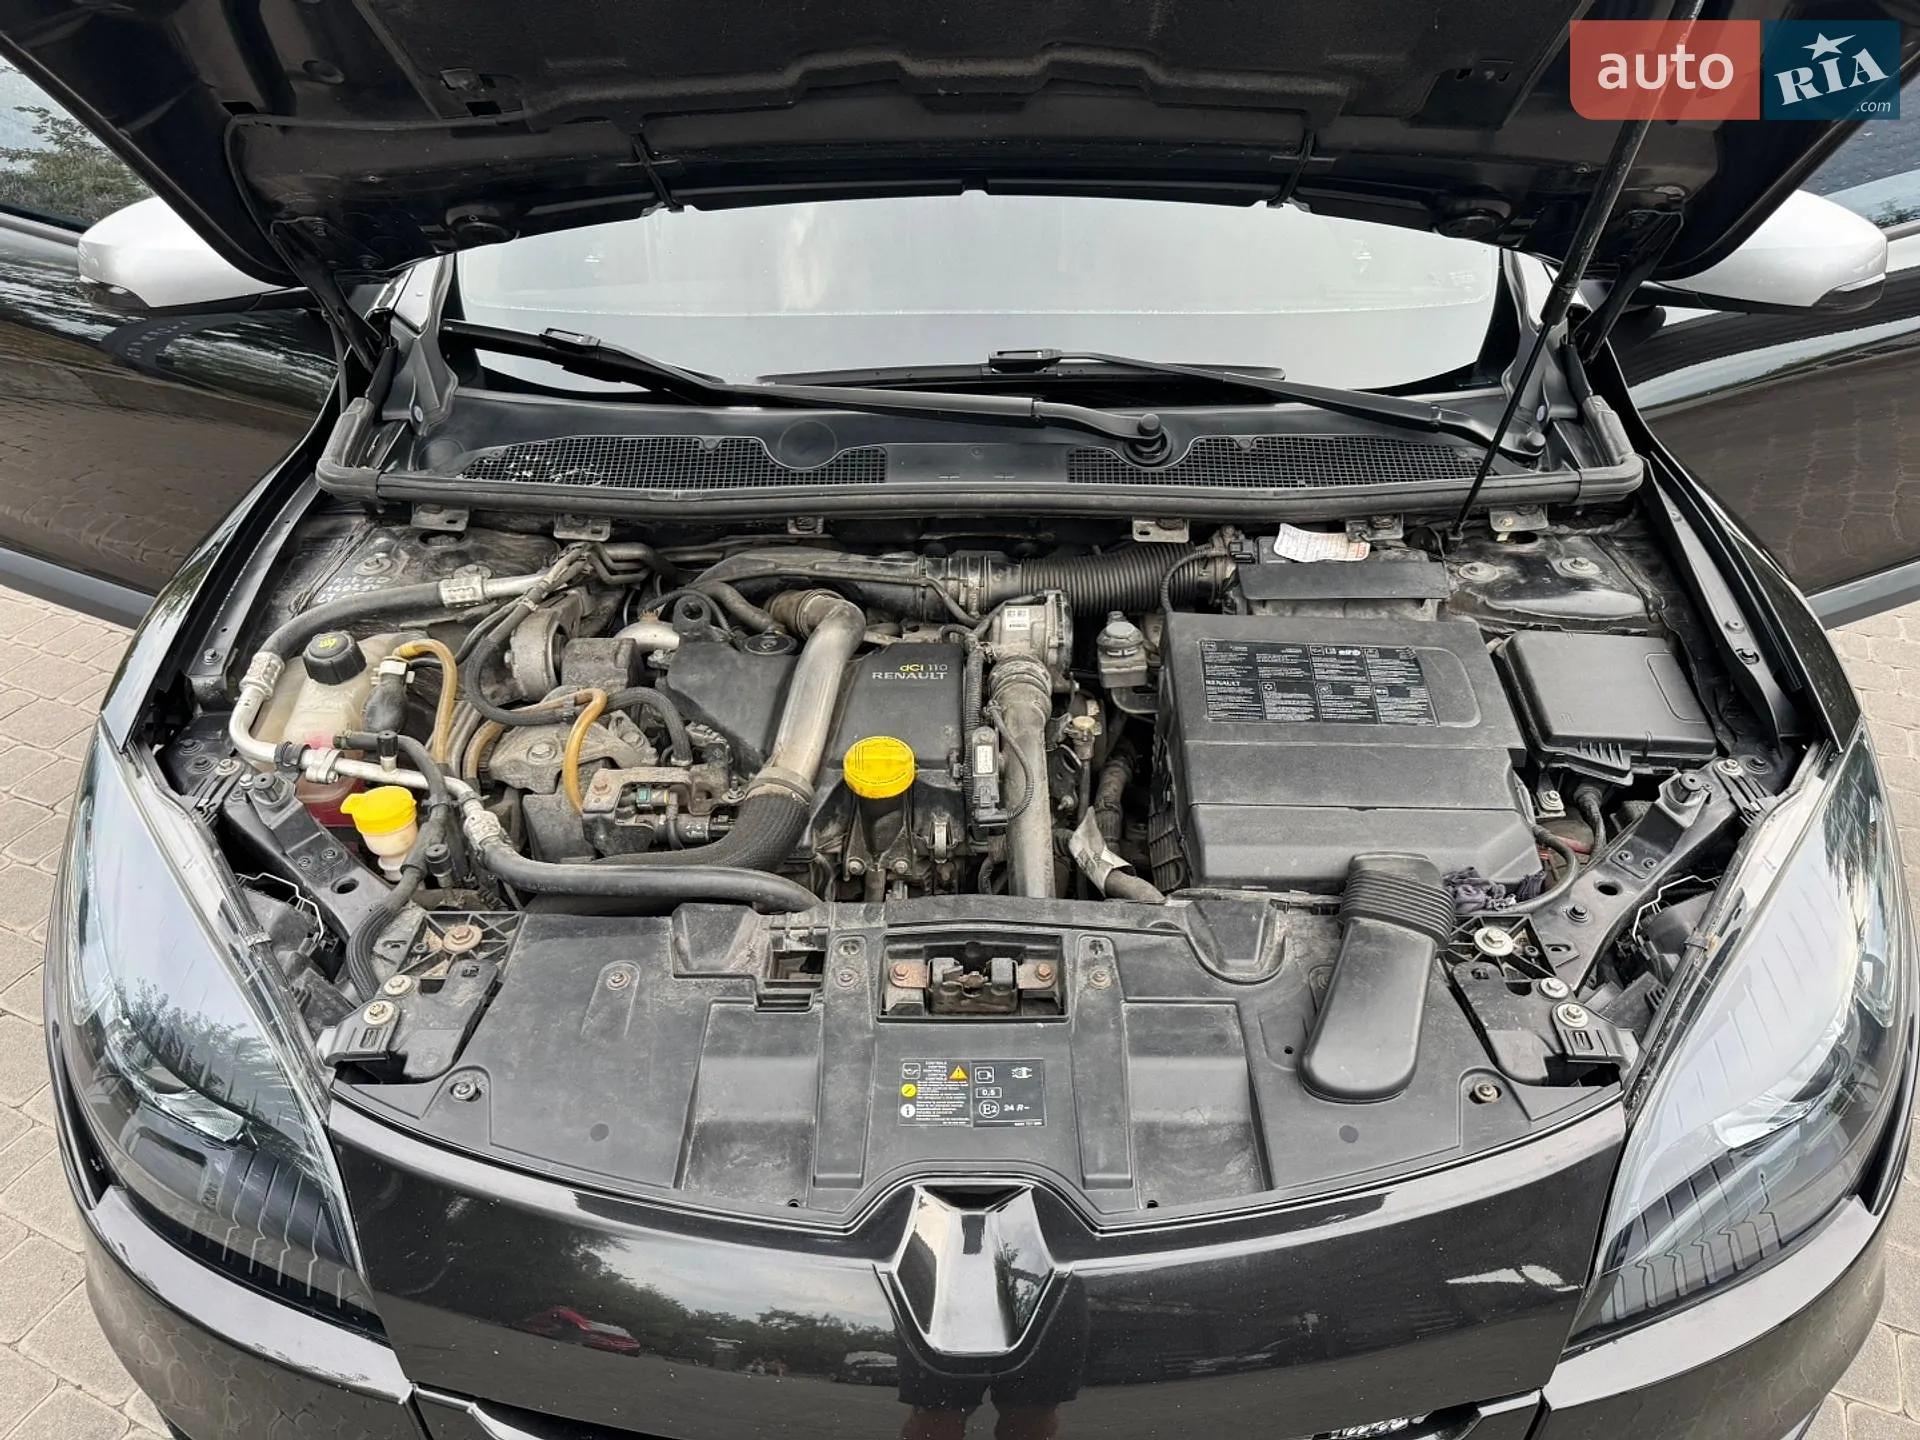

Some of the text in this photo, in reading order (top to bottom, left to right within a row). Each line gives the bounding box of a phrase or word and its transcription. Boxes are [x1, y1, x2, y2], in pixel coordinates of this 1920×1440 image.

[928, 663, 948, 672] 110
[871, 671, 948, 680] RENAULT
[1205, 679, 1241, 687] RENAULT
